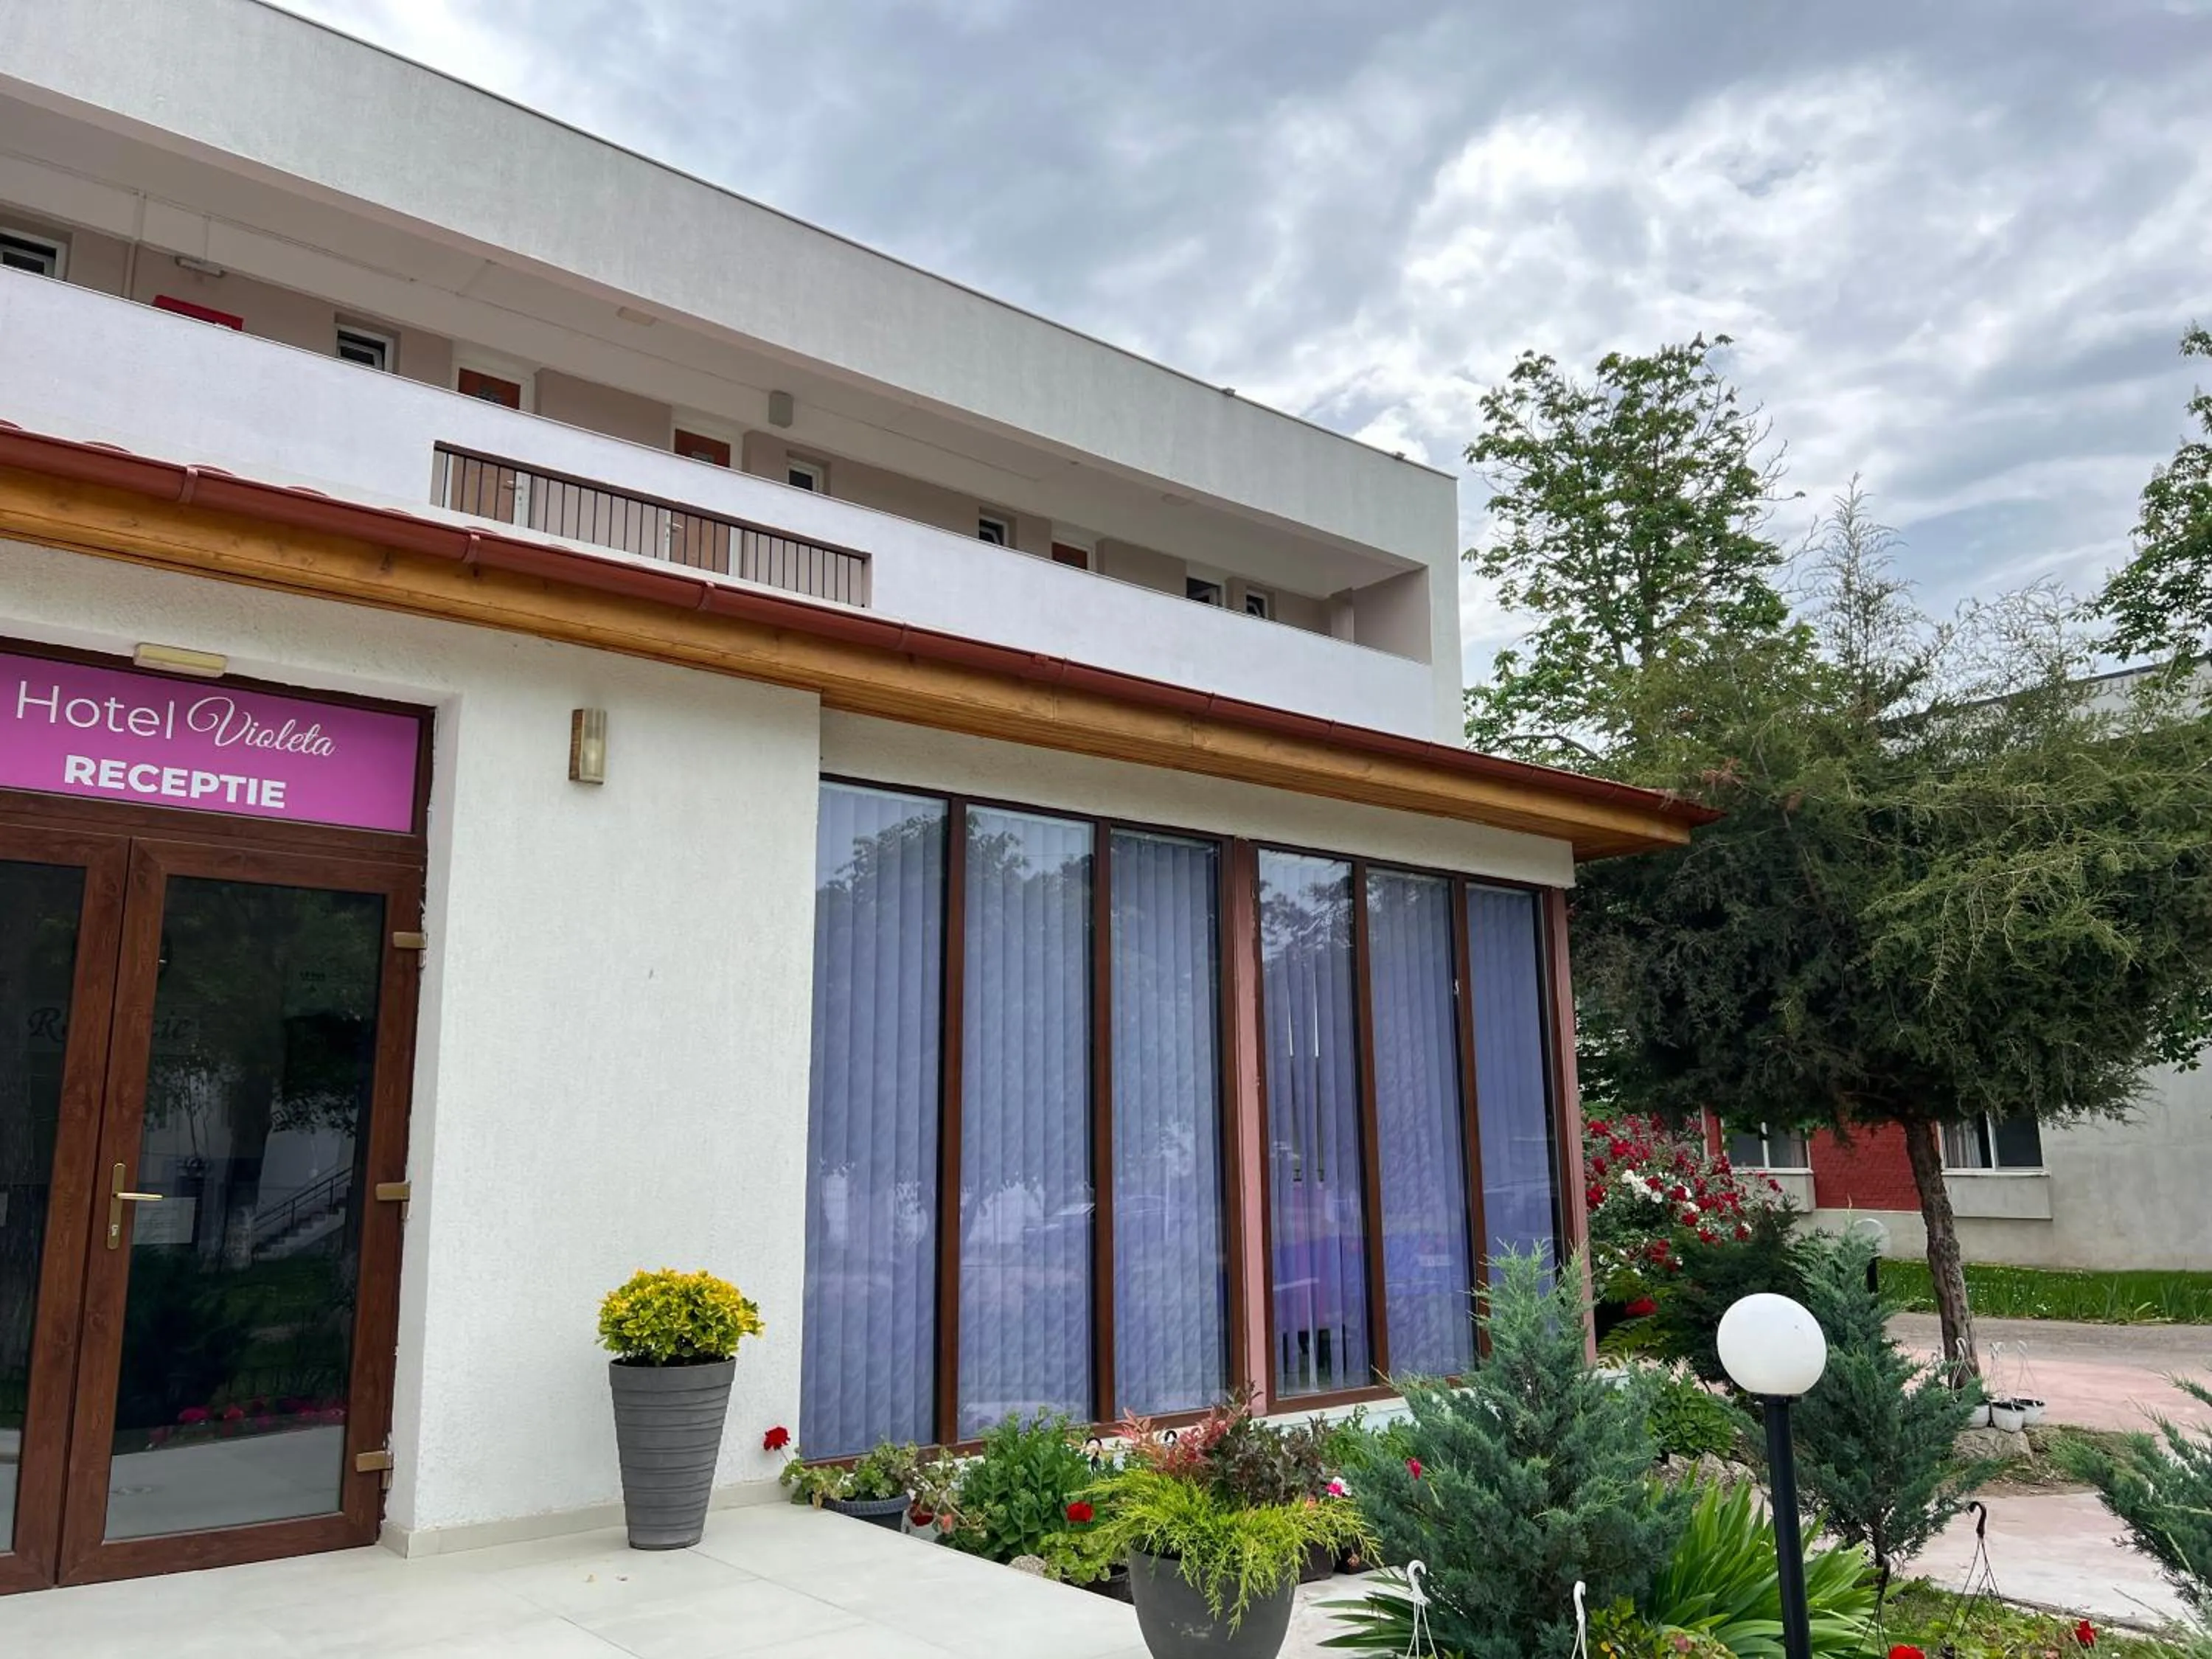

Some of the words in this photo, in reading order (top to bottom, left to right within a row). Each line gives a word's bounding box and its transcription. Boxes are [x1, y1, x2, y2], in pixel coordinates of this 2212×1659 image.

[16, 680, 175, 740] Hotel
[187, 696, 335, 757] Violeta
[63, 754, 287, 809] RECEPTIE
